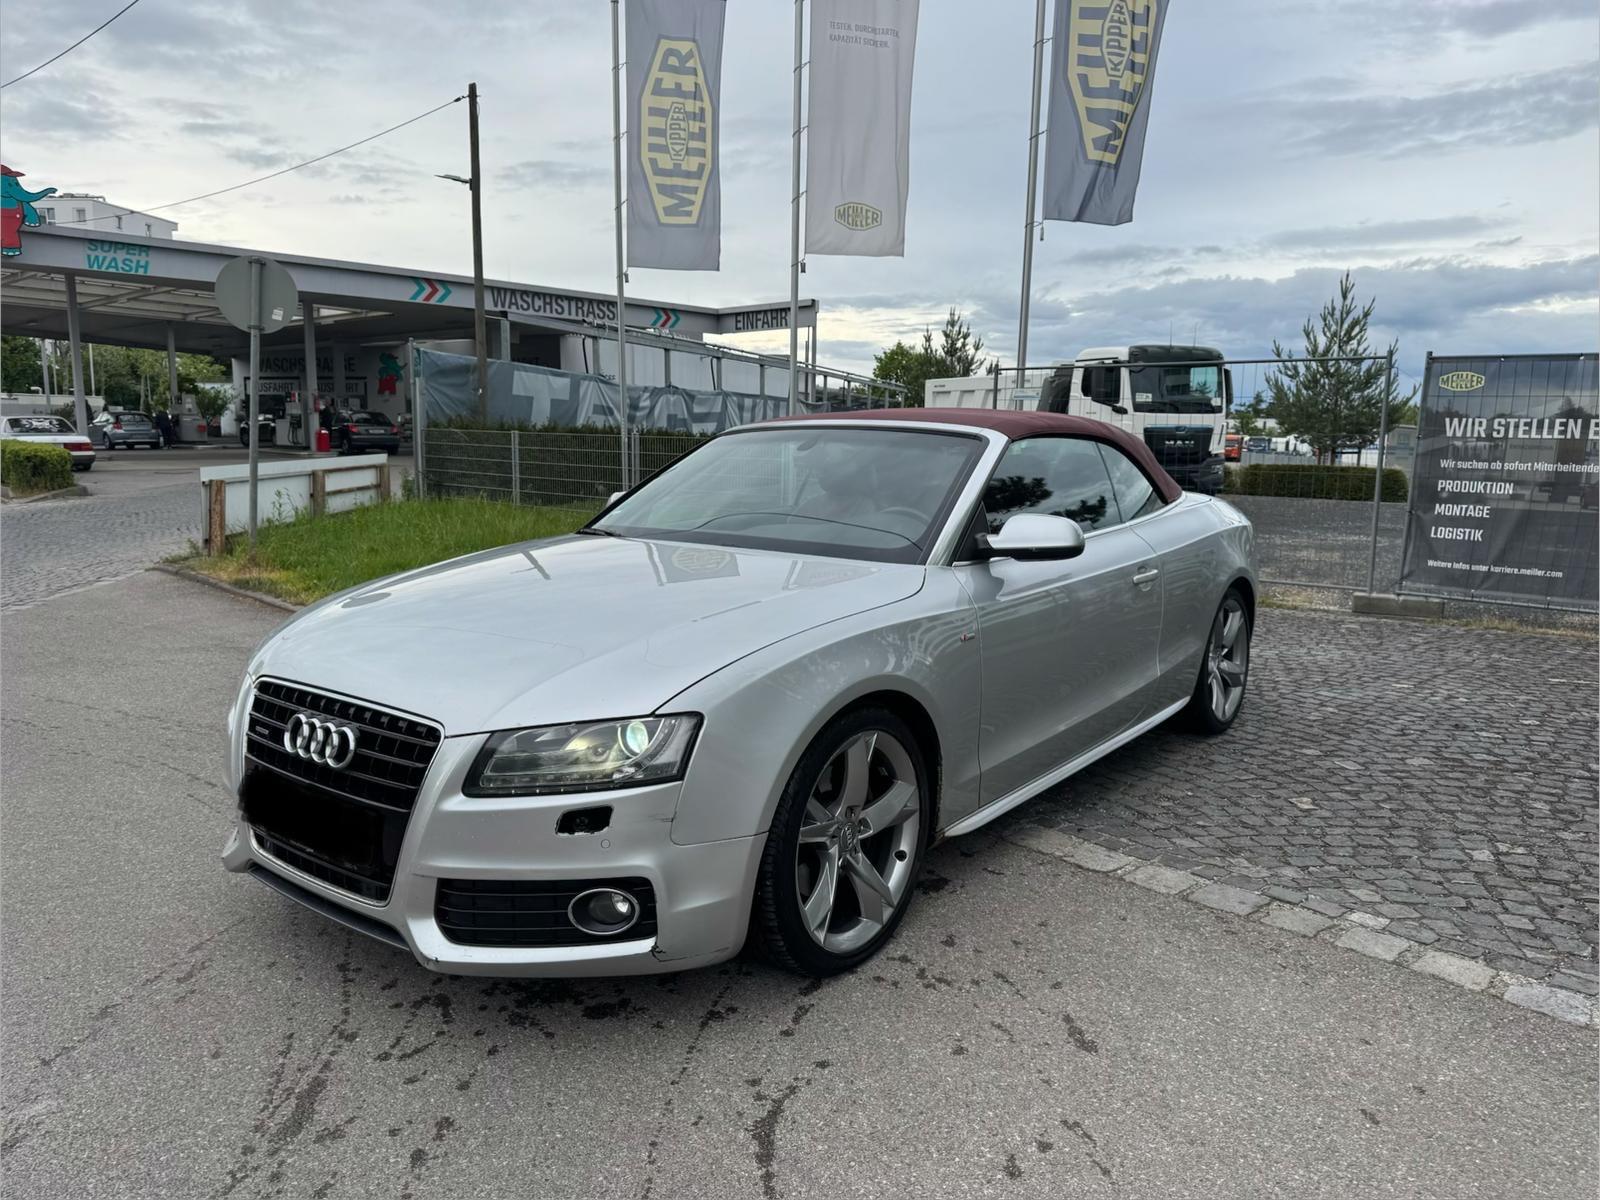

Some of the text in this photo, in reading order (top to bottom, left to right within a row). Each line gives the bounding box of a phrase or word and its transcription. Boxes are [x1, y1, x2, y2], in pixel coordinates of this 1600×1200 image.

[1105, 3, 1127, 72] KIPPER
[648, 47, 707, 217] MEILLER
[669, 105, 687, 157] KIPPER
[838, 205, 880, 228] MEILLER
[87, 240, 149, 257] SUPER
[86, 254, 150, 275] WASH
[491, 287, 619, 321] WASCHSTRASS
[734, 304, 791, 331] EINFAHR
[258, 381, 295, 393] USFAHRT
[1439, 372, 1484, 389] MEILLER
[1444, 417, 1600, 440] WIR STELLEN E
[1440, 459, 1456, 468] Wir
[1457, 460, 1489, 470] suchen
[1490, 460, 1502, 470] ab
[1503, 460, 1532, 471] sofort
[1437, 480, 1514, 495] PRODUKTION
[1434, 503, 1491, 518] MONTAGE
[1430, 526, 1484, 542] LOGISTIK
[1427, 560, 1452, 568] Weitere
[1471, 564, 1490, 572] unter
